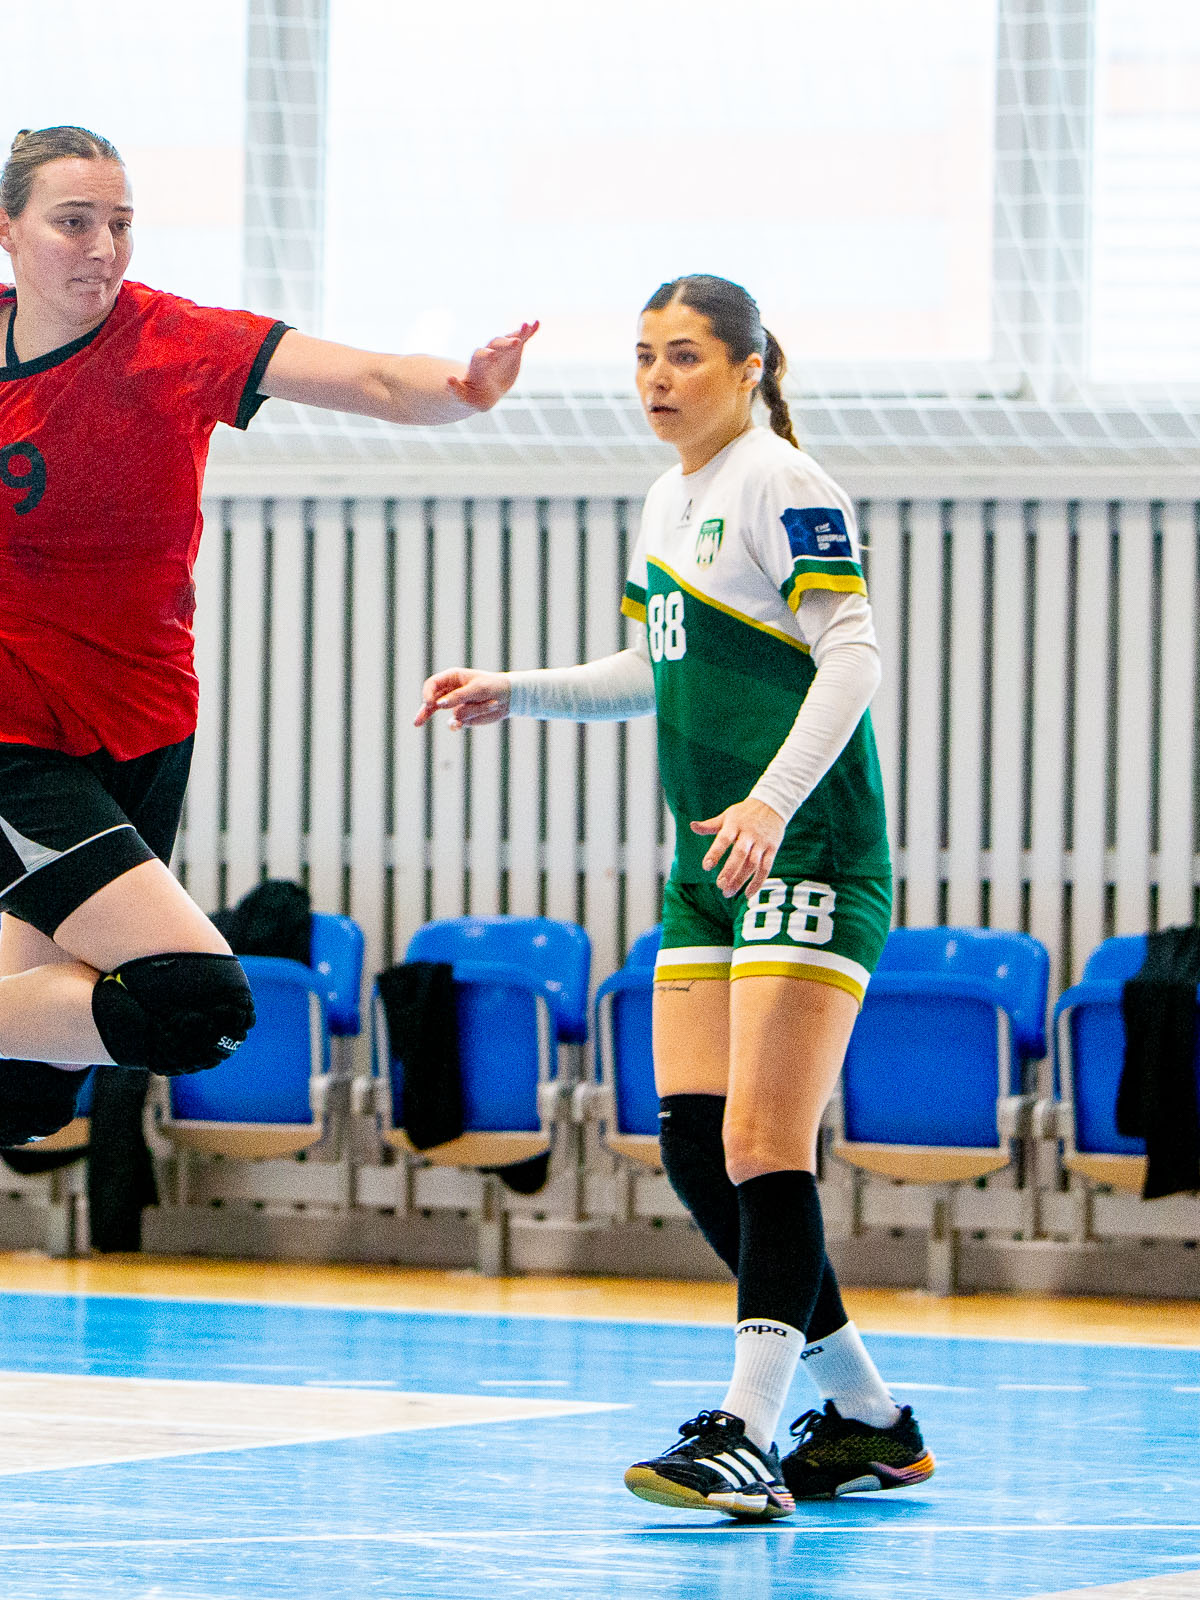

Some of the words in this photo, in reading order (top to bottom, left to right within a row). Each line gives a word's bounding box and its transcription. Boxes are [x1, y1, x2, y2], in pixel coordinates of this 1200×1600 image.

[648, 590, 687, 663] 88
[741, 877, 837, 946] 88
[737, 1324, 788, 1338] mpa
